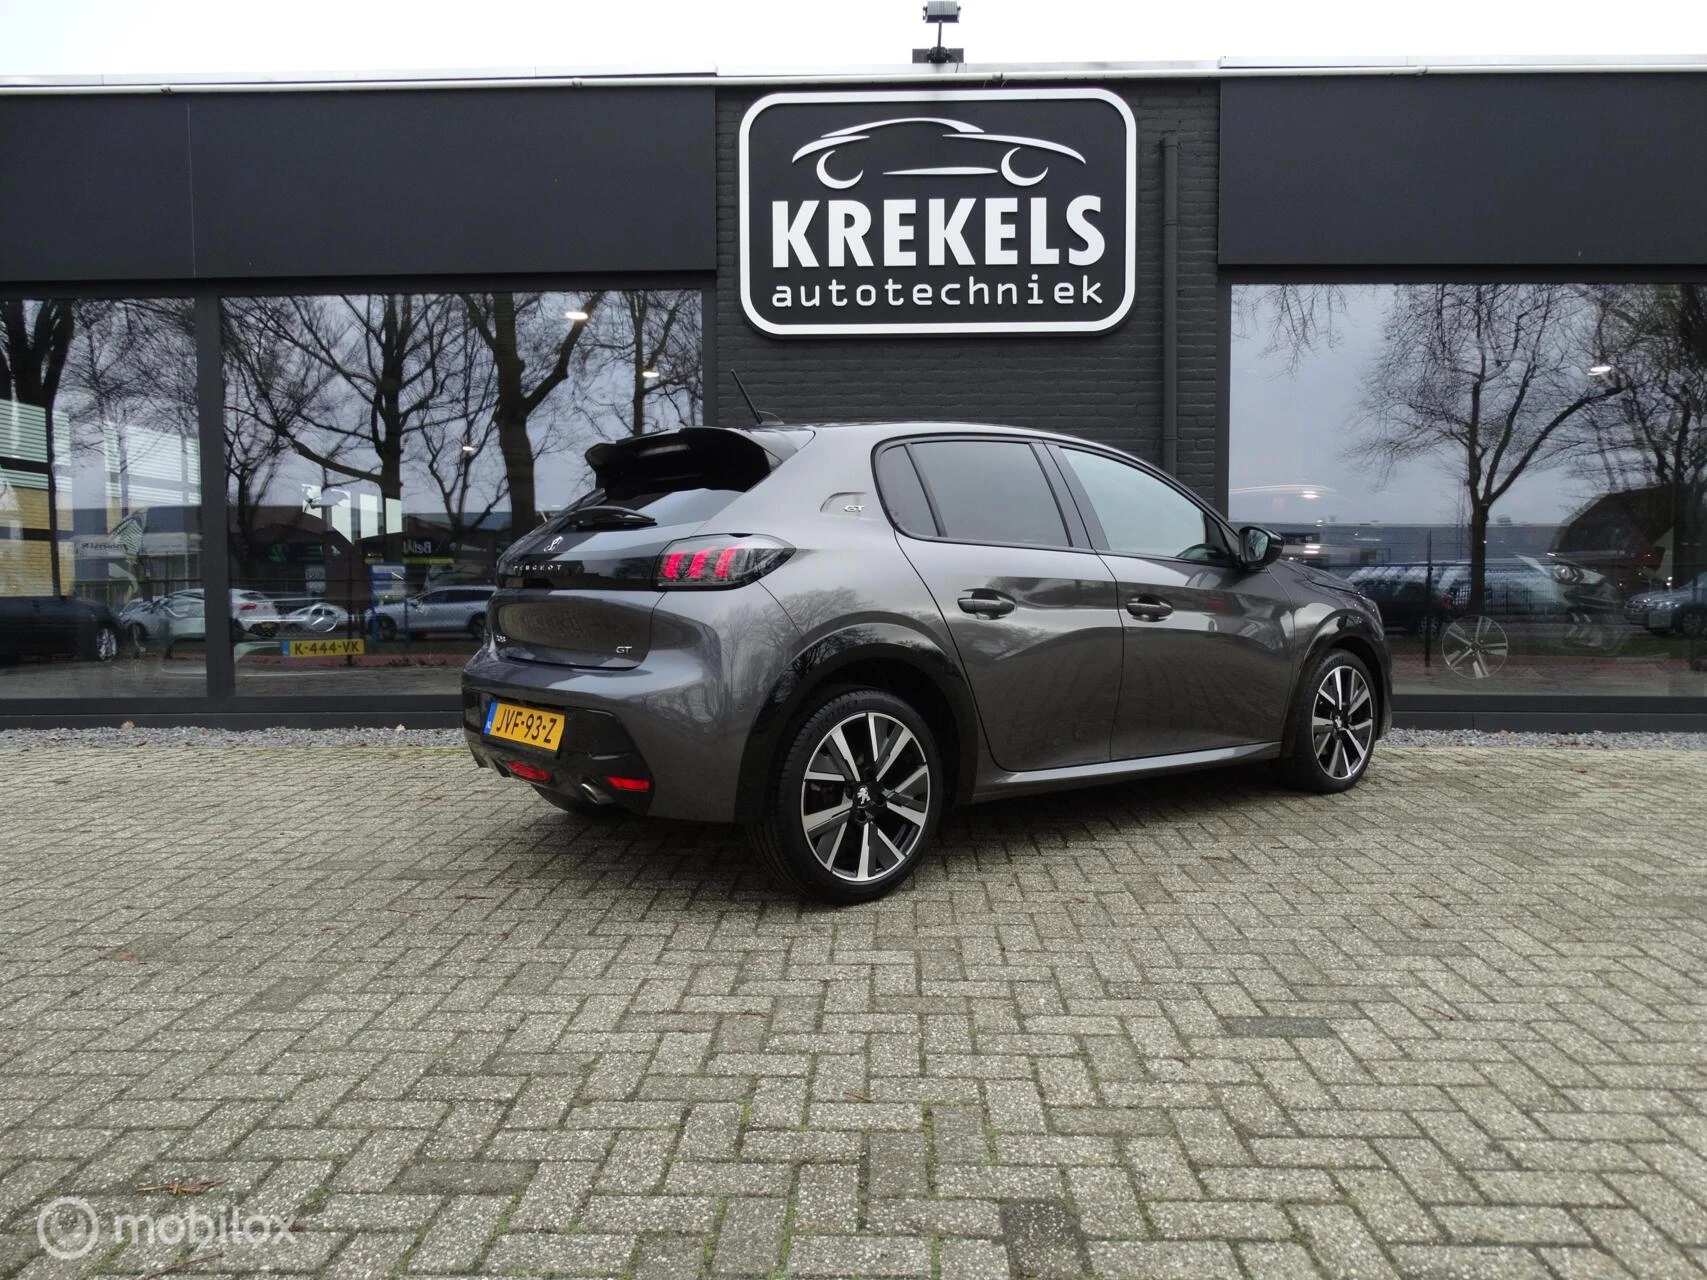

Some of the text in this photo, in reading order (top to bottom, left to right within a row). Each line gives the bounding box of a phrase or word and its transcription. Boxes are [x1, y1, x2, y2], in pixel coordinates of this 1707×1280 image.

[771, 194, 1106, 268] KREKELS
[771, 274, 1103, 308] autotechniek
[843, 504, 866, 514] GT
[294, 640, 360, 655] K-444-VK
[615, 646, 633, 654] GT
[496, 708, 558, 744] JVF-93-Z
